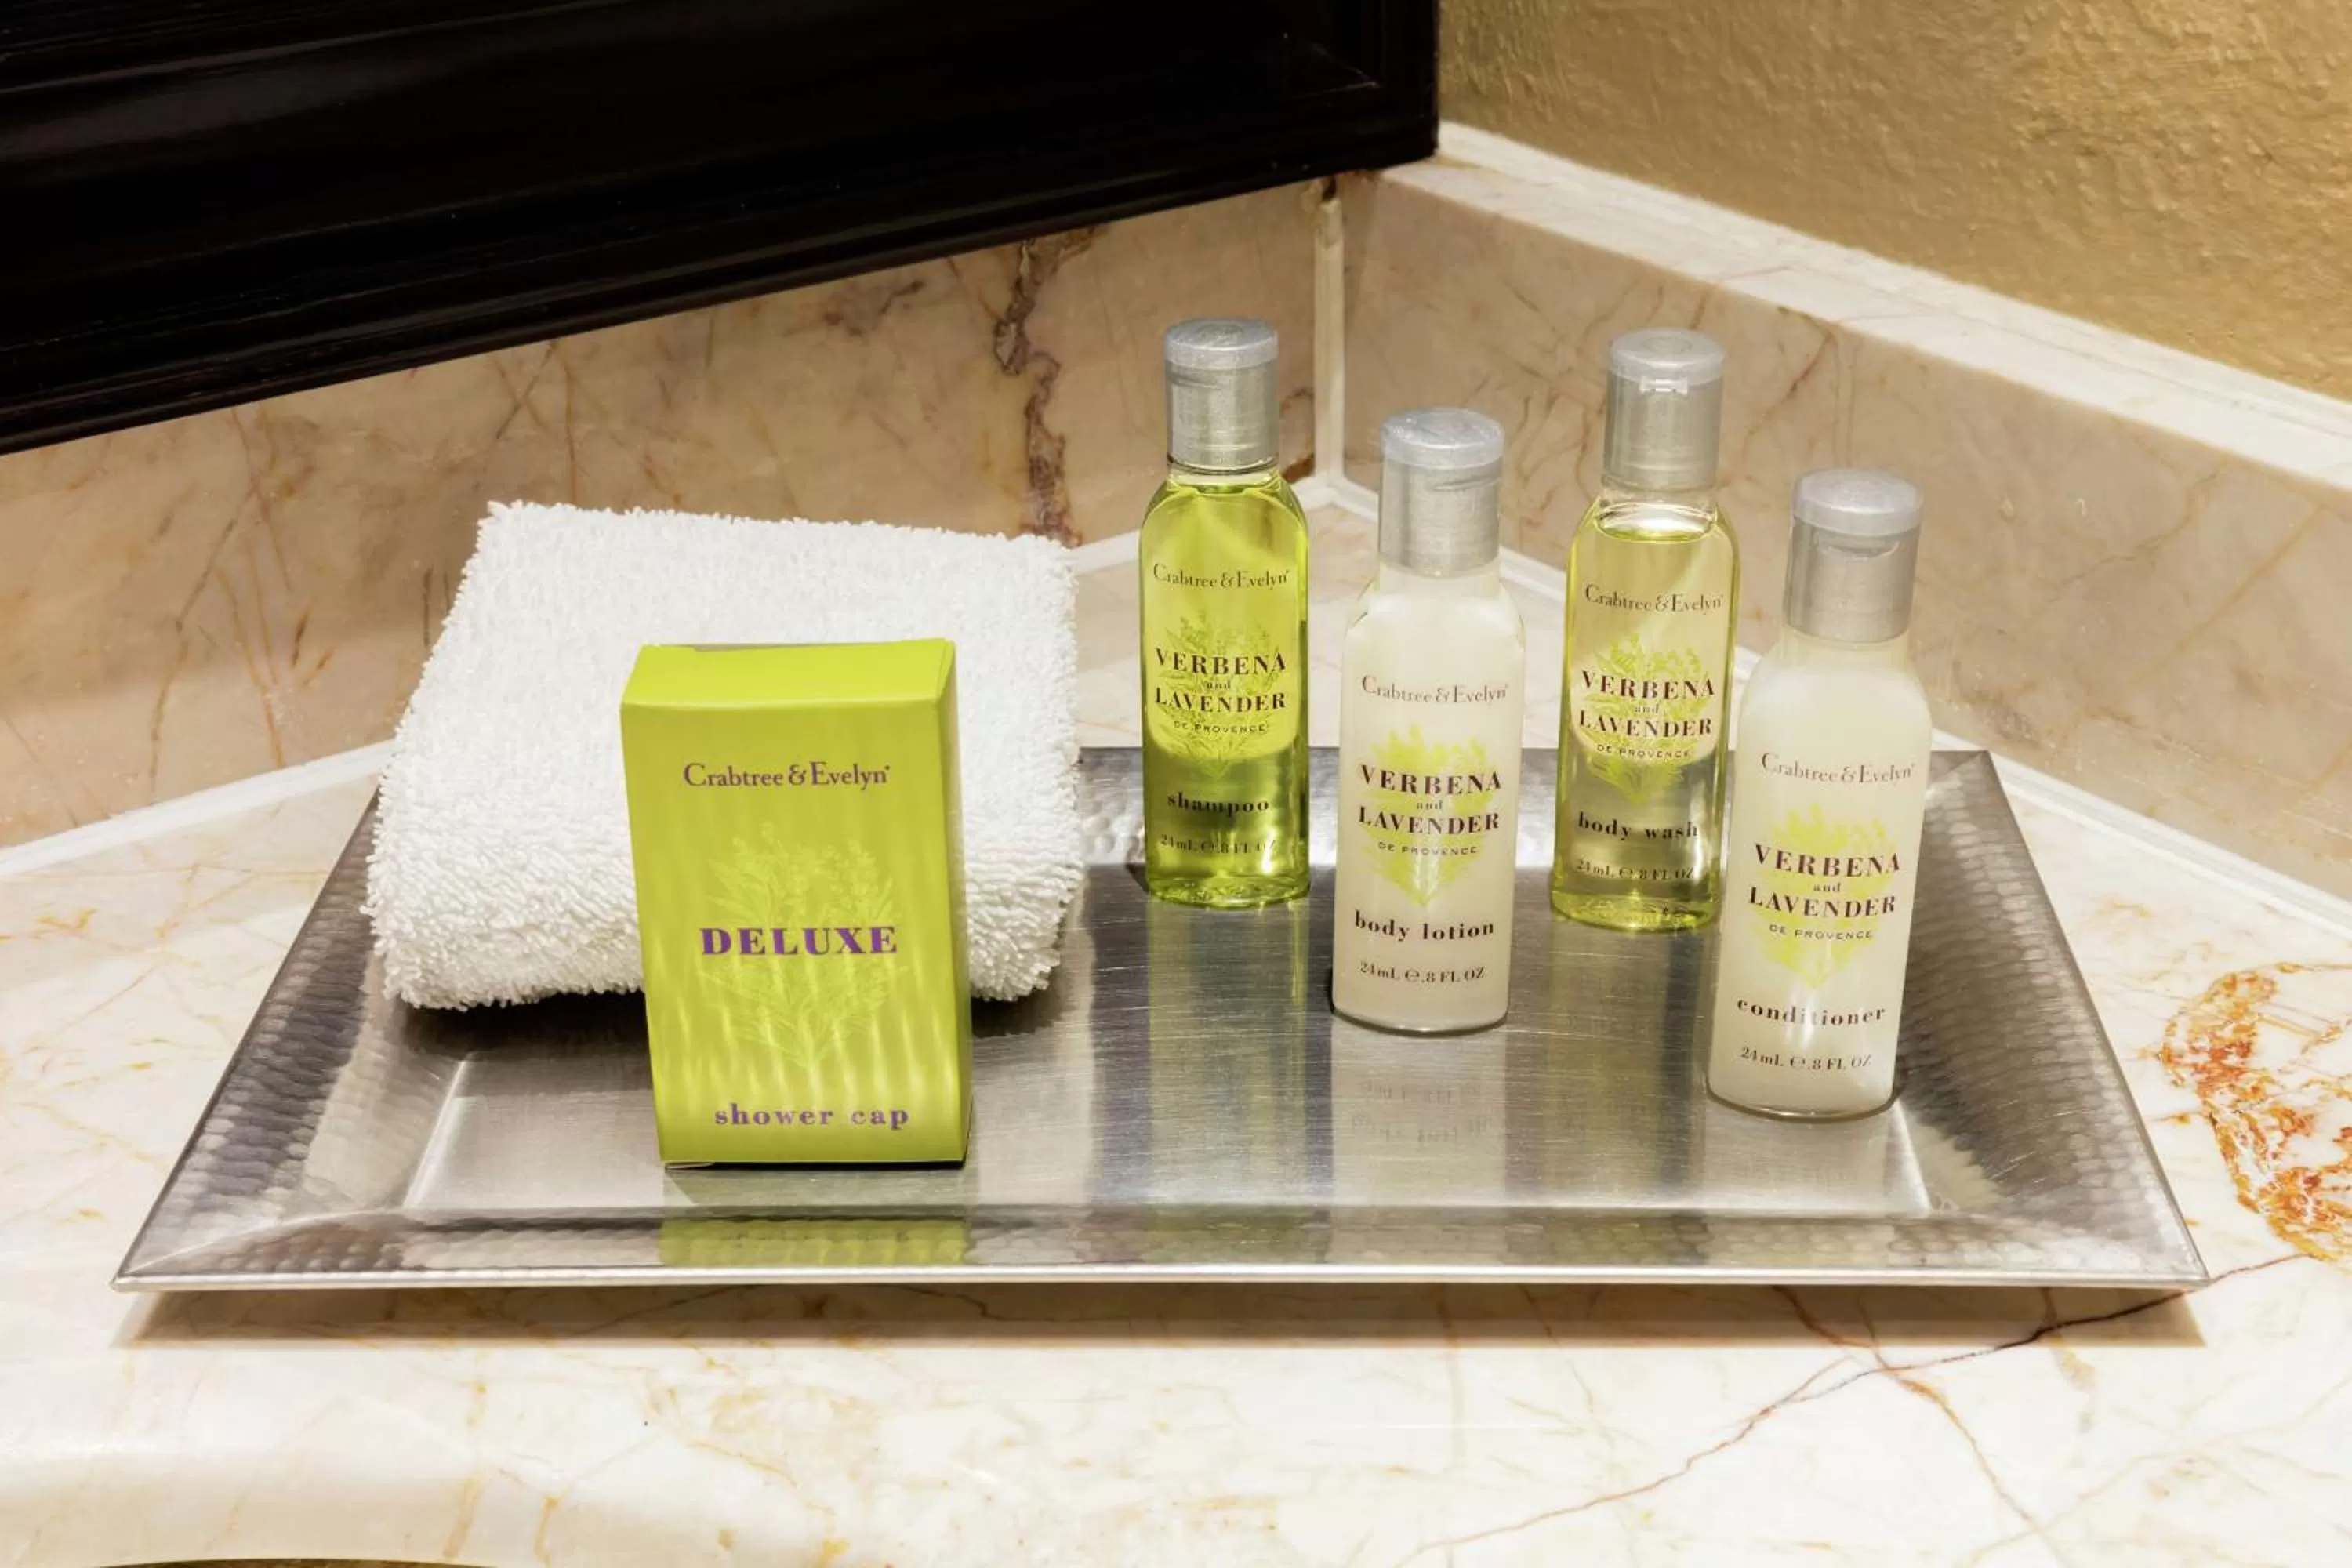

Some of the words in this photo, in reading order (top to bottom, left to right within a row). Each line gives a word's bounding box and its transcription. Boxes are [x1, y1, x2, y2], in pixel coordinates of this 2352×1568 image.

[1153, 563, 1217, 588] Crabtree
[1220, 572, 1233, 589] &
[1584, 583, 1653, 611] Crabtree
[1655, 595, 1669, 612] &
[1155, 648, 1287, 676] VERBENA
[1361, 674, 1434, 703] Crabtree
[1436, 687, 1450, 704] &
[1581, 670, 1715, 700] VERBENA
[1154, 686, 1287, 713] LAVENDER
[1194, 722, 1269, 734] PROVENCE
[1579, 710, 1712, 738] LAVENDER
[1618, 748, 1690, 760] PROVENCE
[1761, 751, 1840, 782] Crabtree
[1840, 765, 1856, 783] &
[683, 761, 784, 787] Crabtree
[787, 764, 808, 787] &
[1360, 764, 1502, 795] VERBENA
[1167, 791, 1270, 818] shampoo
[1416, 800, 1443, 810] and
[1358, 805, 1500, 835] LAVENDER
[1577, 811, 1632, 841] body
[1645, 820, 1698, 840] wash
[1377, 840, 1395, 852] DE
[1401, 845, 1478, 856] PROVENCE
[1755, 843, 1901, 878] VERBENA
[1813, 882, 1842, 892] and
[1748, 886, 1896, 918] LAVENDER
[1355, 909, 1410, 942] body
[1422, 922, 1494, 940] lotion
[1769, 924, 1788, 935] DE
[1794, 928, 1874, 941] PROVENCE
[700, 925, 898, 956] DELUXE
[1737, 998, 1886, 1026] conditioner
[714, 1103, 834, 1127] shower
[851, 1109, 909, 1131] cap
